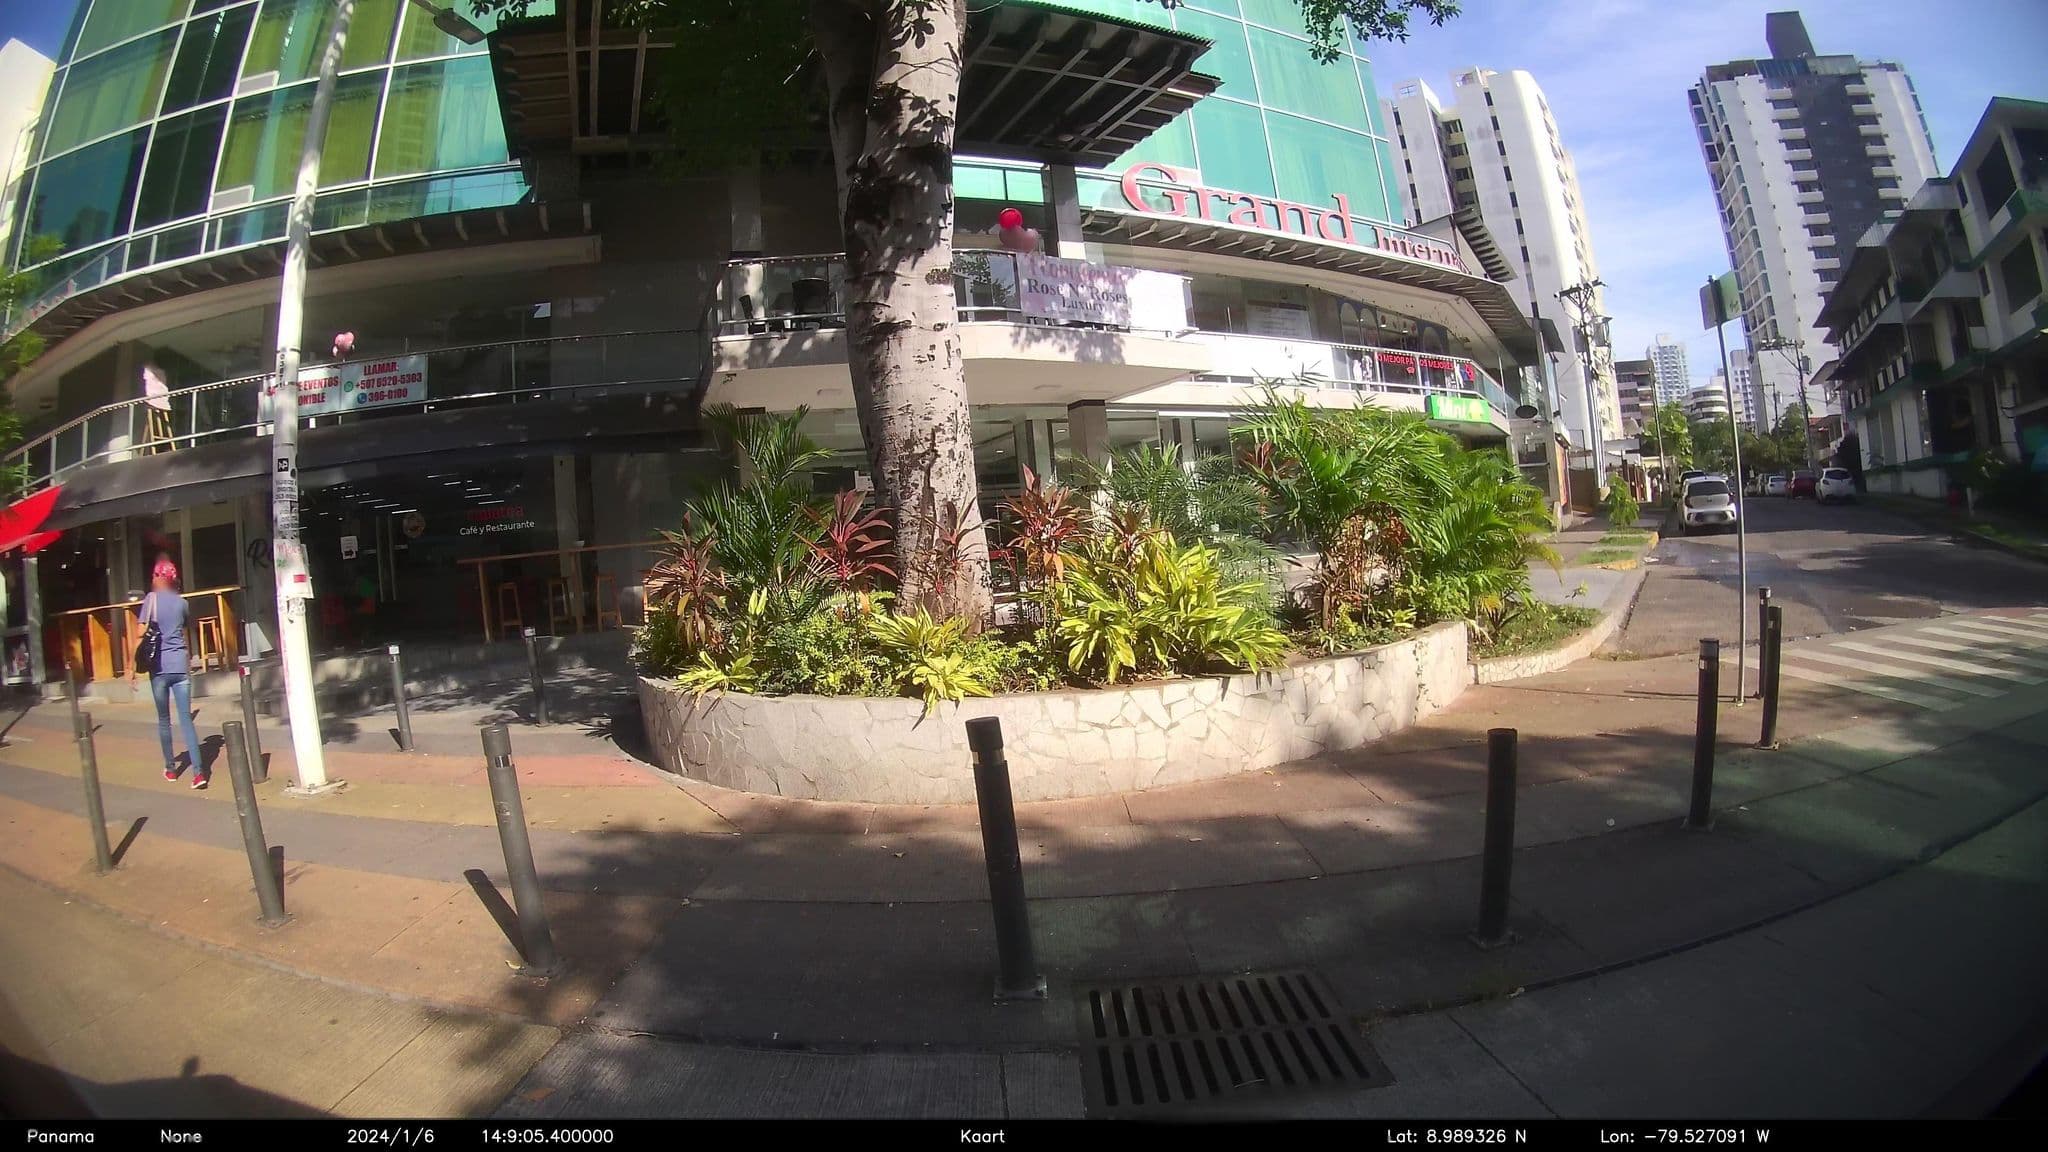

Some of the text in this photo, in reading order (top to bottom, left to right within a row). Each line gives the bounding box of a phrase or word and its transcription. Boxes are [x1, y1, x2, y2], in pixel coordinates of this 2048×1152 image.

[1121, 162, 1358, 246] Grand
[1027, 278, 1064, 296] Rose
[1088, 286, 1128, 304] Roses
[1062, 296, 1105, 316] Luxury
[1383, 354, 1406, 365] MEJOR
[303, 375, 339, 391] EVENTOS
[355, 377, 375, 390] +507
[298, 391, 326, 406] ONIBLE
[459, 519, 535, 536] Café y Restaurante
